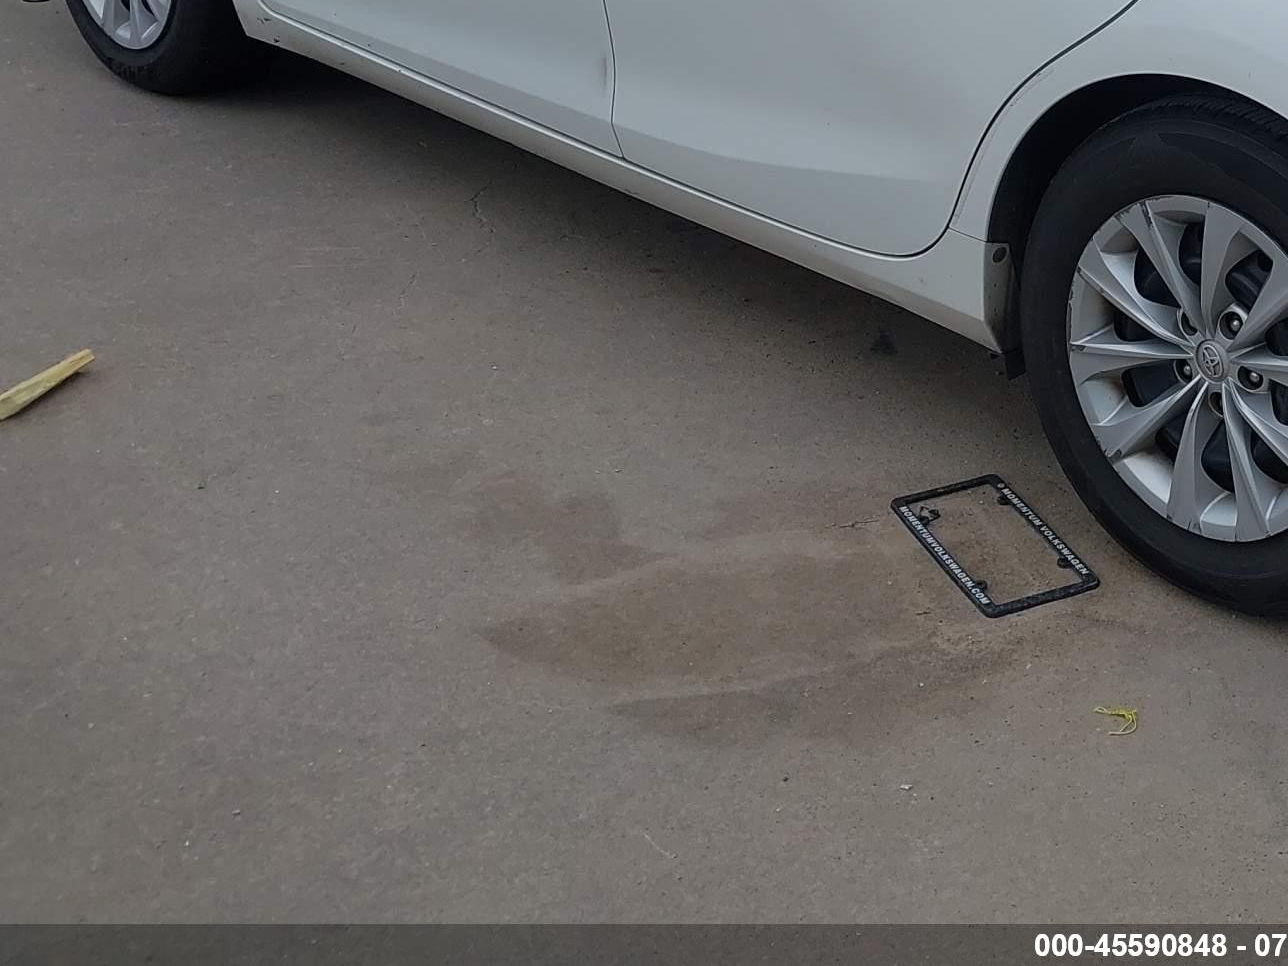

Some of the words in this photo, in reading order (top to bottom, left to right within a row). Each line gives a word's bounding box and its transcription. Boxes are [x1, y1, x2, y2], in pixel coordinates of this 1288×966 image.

[899, 506, 991, 605] MOMENTUMVOLKSWAGEN.COM
[1001, 488, 1043, 526] MOMENTUM
[1040, 525, 1090, 575] VOLKSWAGEN
